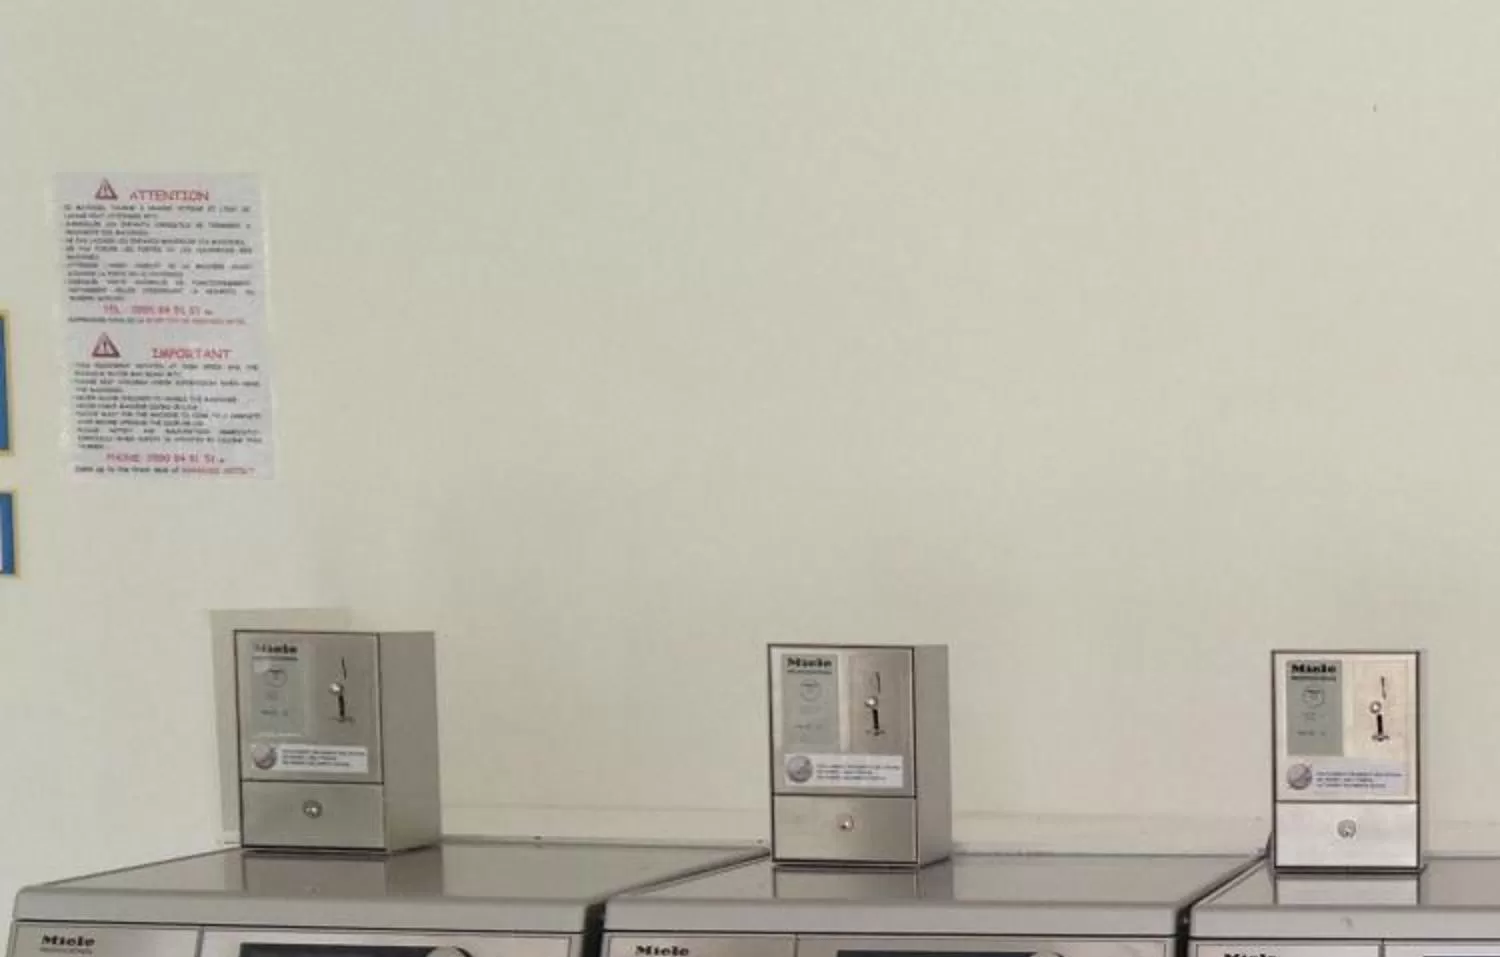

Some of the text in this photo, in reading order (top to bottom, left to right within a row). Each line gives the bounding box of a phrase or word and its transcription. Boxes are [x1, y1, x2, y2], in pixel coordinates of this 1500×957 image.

[129, 188, 210, 202] ATTENTION
[151, 347, 233, 360] IMPORTANT
[41, 935, 96, 947] Miele
[635, 945, 690, 957] Miele
